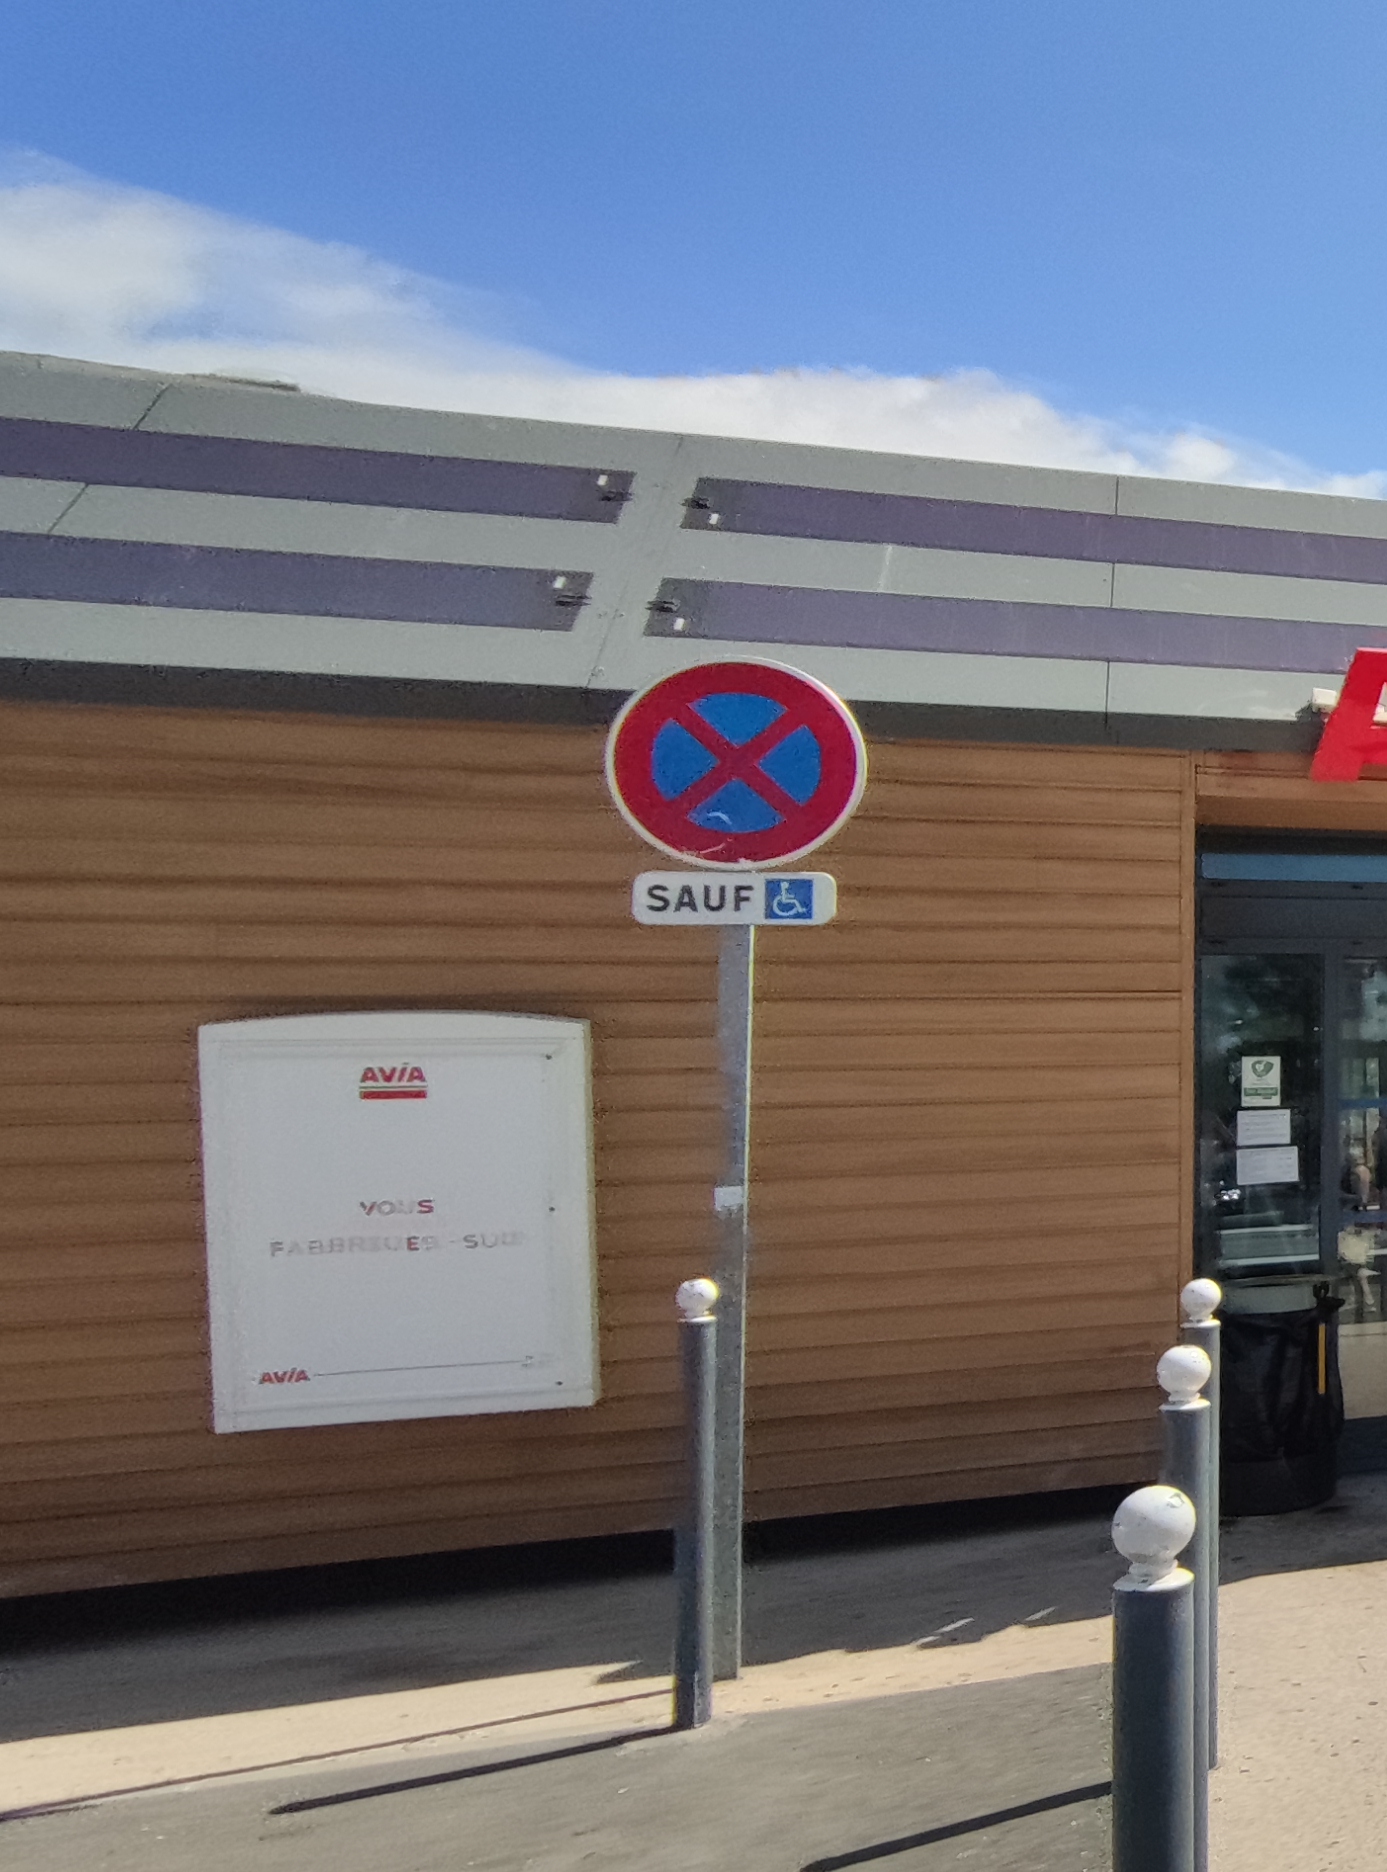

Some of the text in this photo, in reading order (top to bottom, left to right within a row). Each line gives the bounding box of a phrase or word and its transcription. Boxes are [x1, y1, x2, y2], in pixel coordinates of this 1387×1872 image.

[646, 884, 754, 913] SAUF
[359, 1063, 428, 1083] AVIA
[259, 1366, 310, 1384] AVIA
